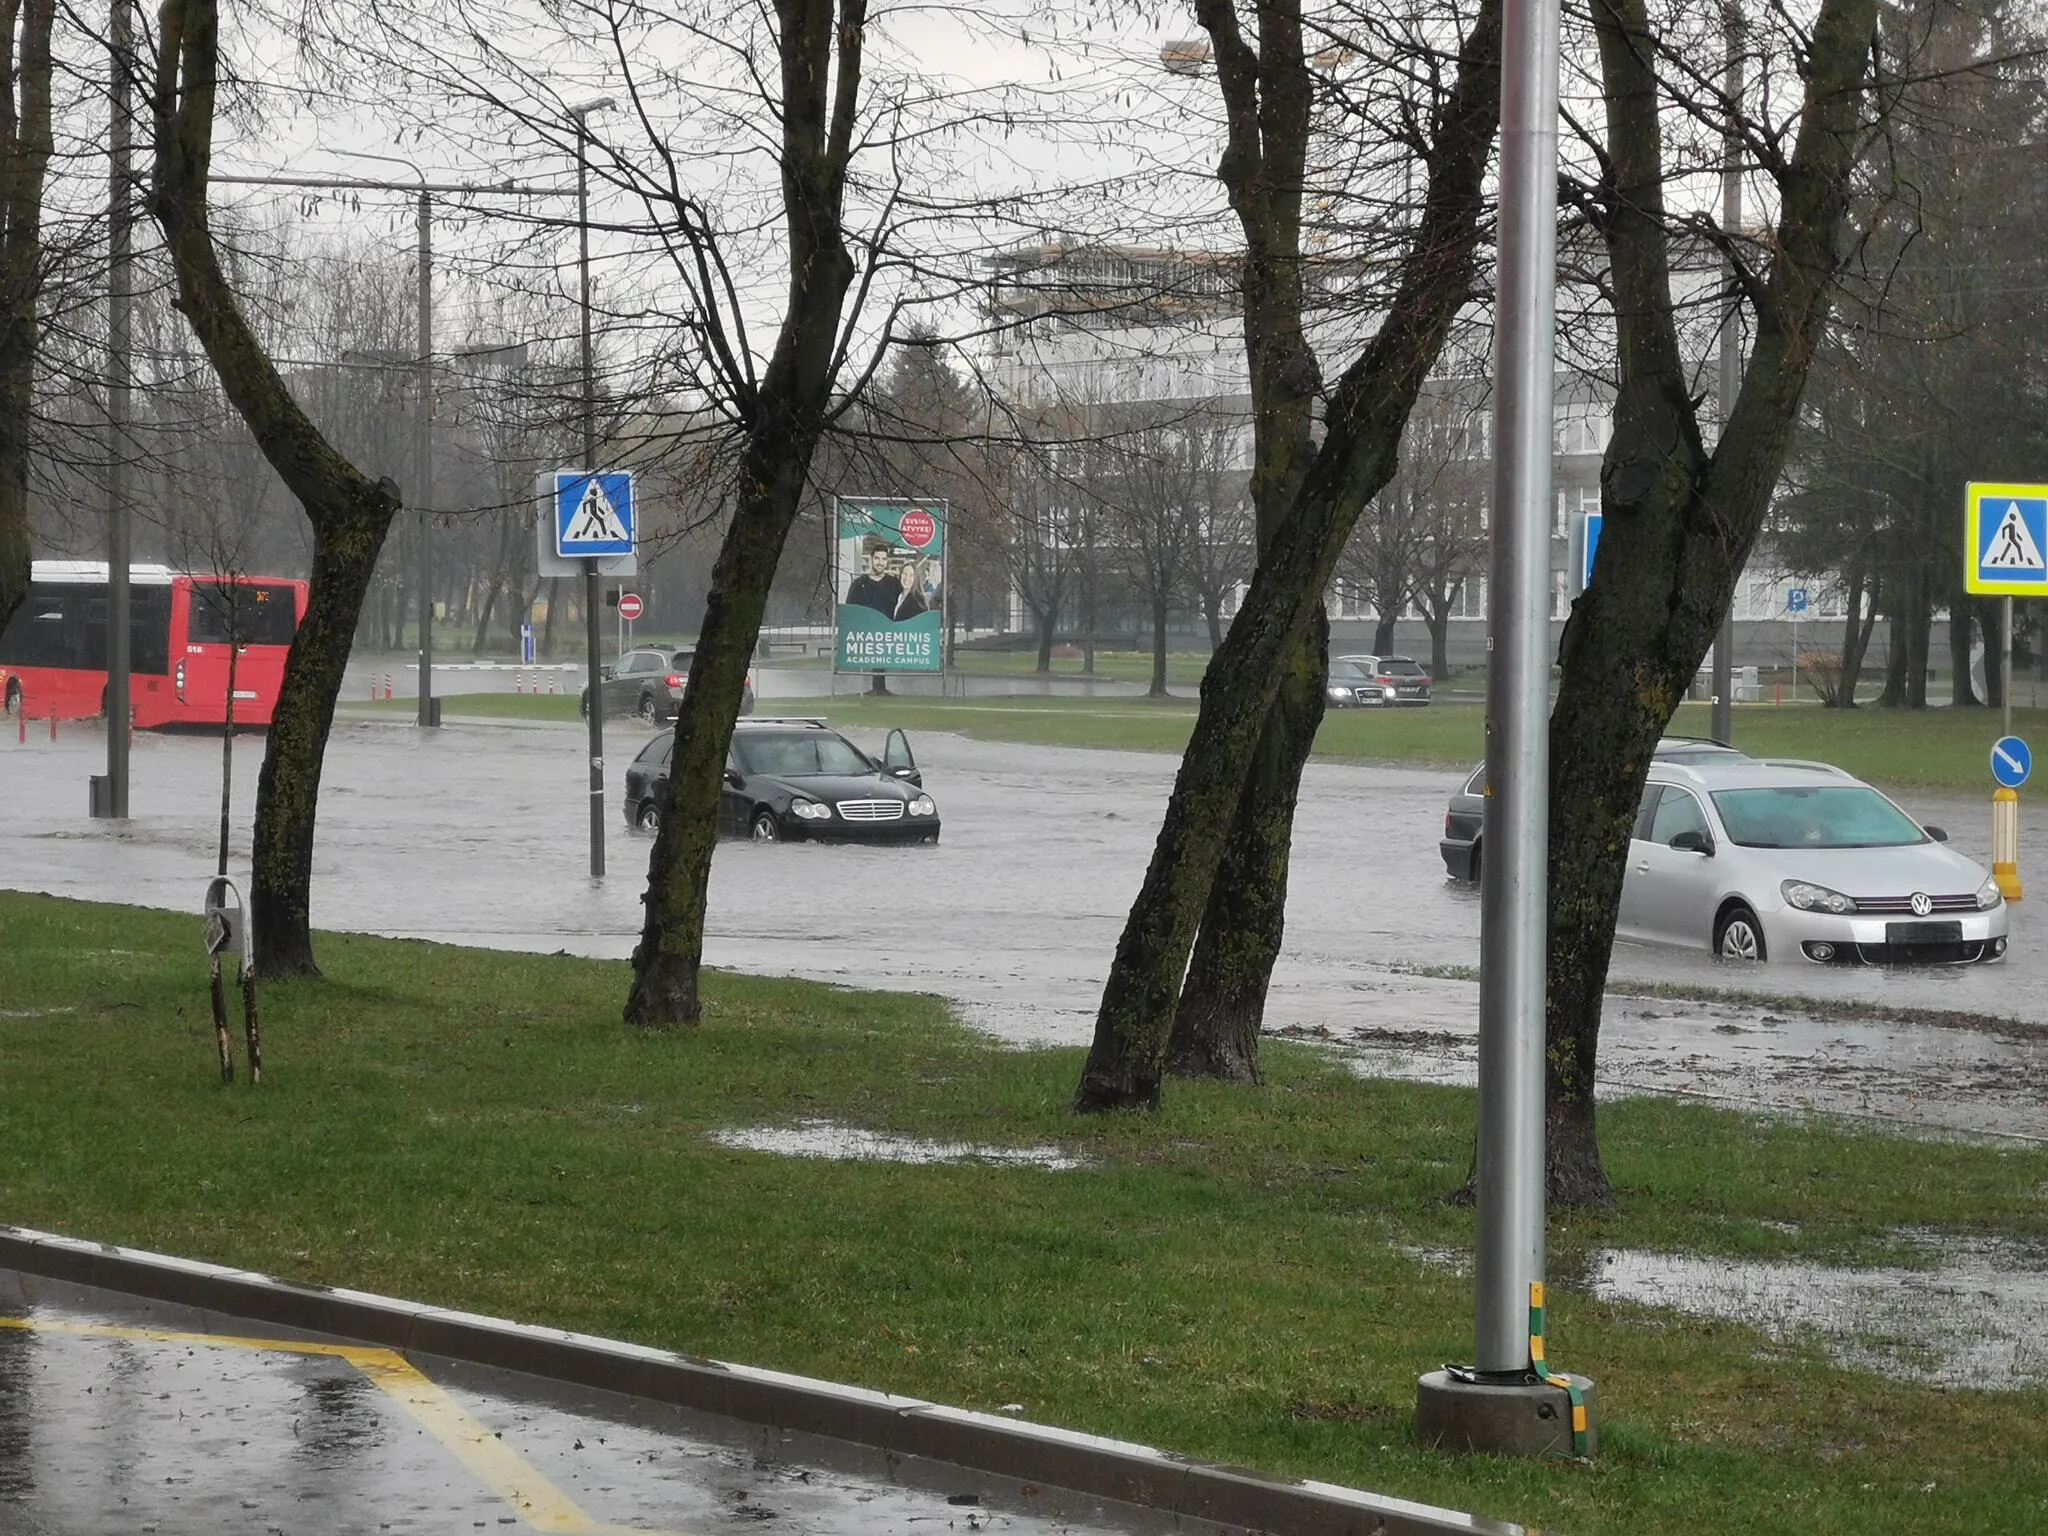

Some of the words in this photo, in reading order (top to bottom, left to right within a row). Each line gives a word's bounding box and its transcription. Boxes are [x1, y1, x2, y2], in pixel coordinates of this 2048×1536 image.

[846, 631, 932, 643] AKADEMINIS
[846, 642, 931, 656] MIESTELIS
[846, 656, 892, 664] ACADEMIC
[894, 657, 930, 665] CAMPUS
